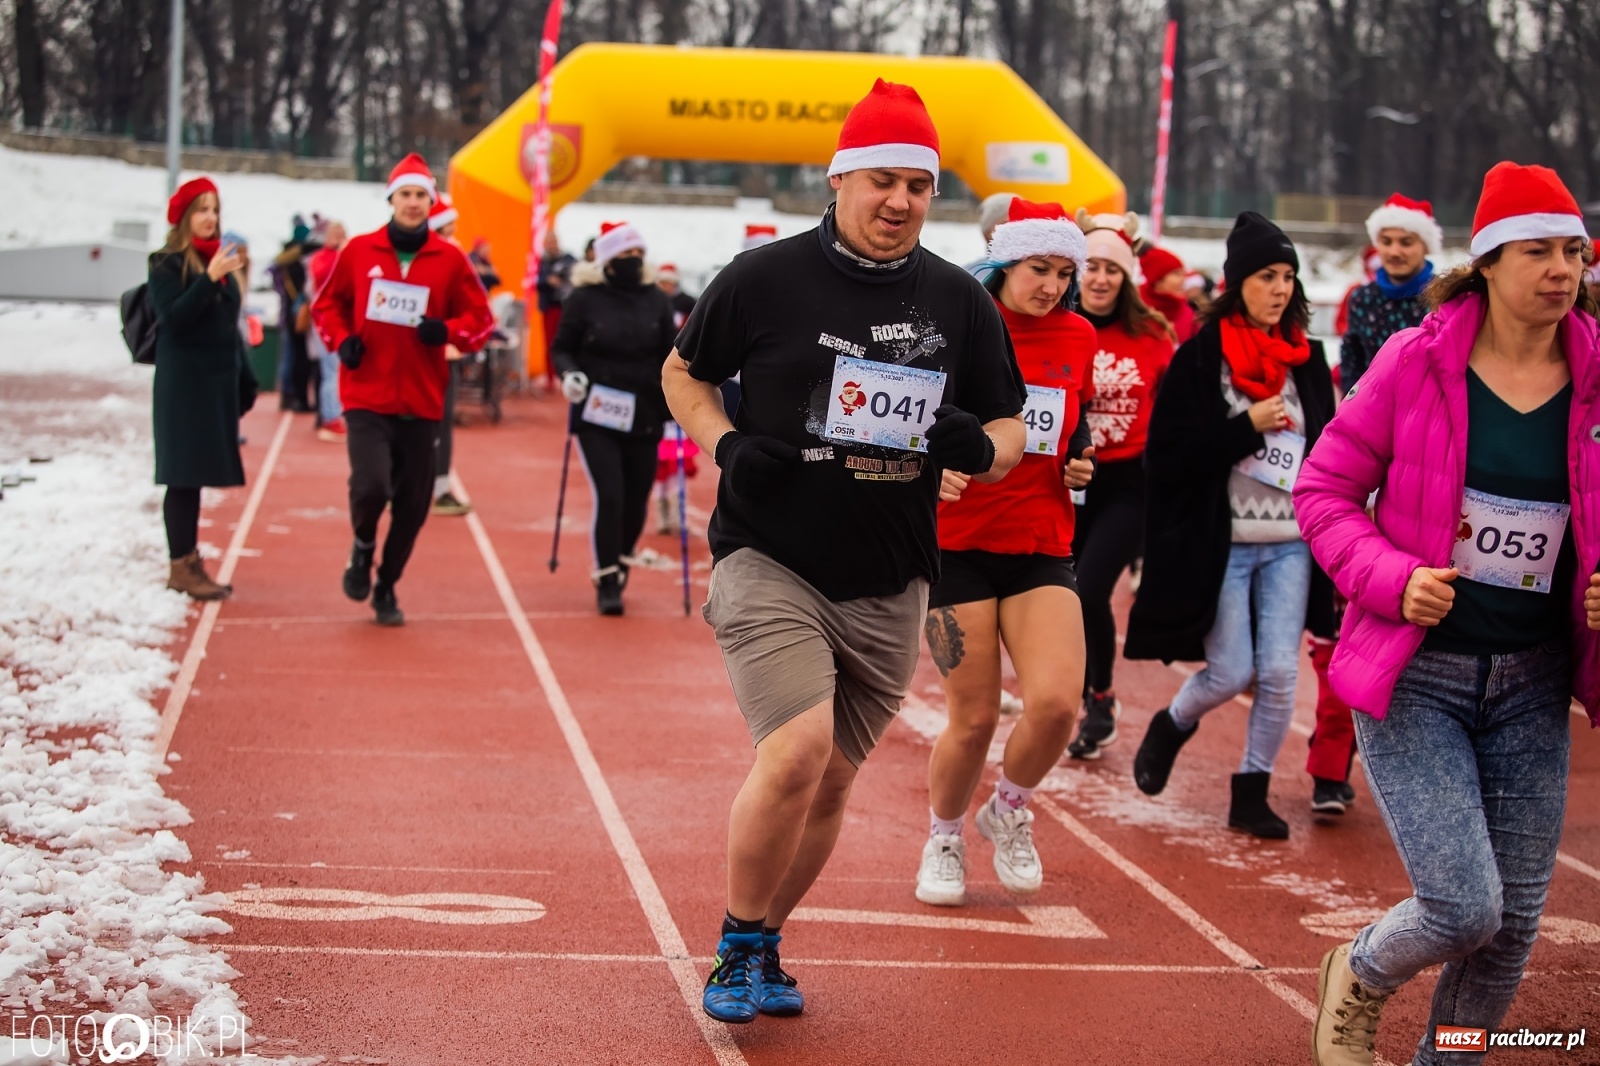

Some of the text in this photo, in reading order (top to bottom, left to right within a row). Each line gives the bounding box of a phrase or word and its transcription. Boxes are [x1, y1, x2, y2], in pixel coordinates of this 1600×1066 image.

[669, 97, 770, 122] MIASTO
[871, 322, 915, 342] ROCK
[870, 391, 927, 425] 041
[845, 455, 883, 472] AROUND
[885, 461, 901, 473] THE
[1254, 447, 1293, 470] 089
[1476, 526, 1549, 561] 053
